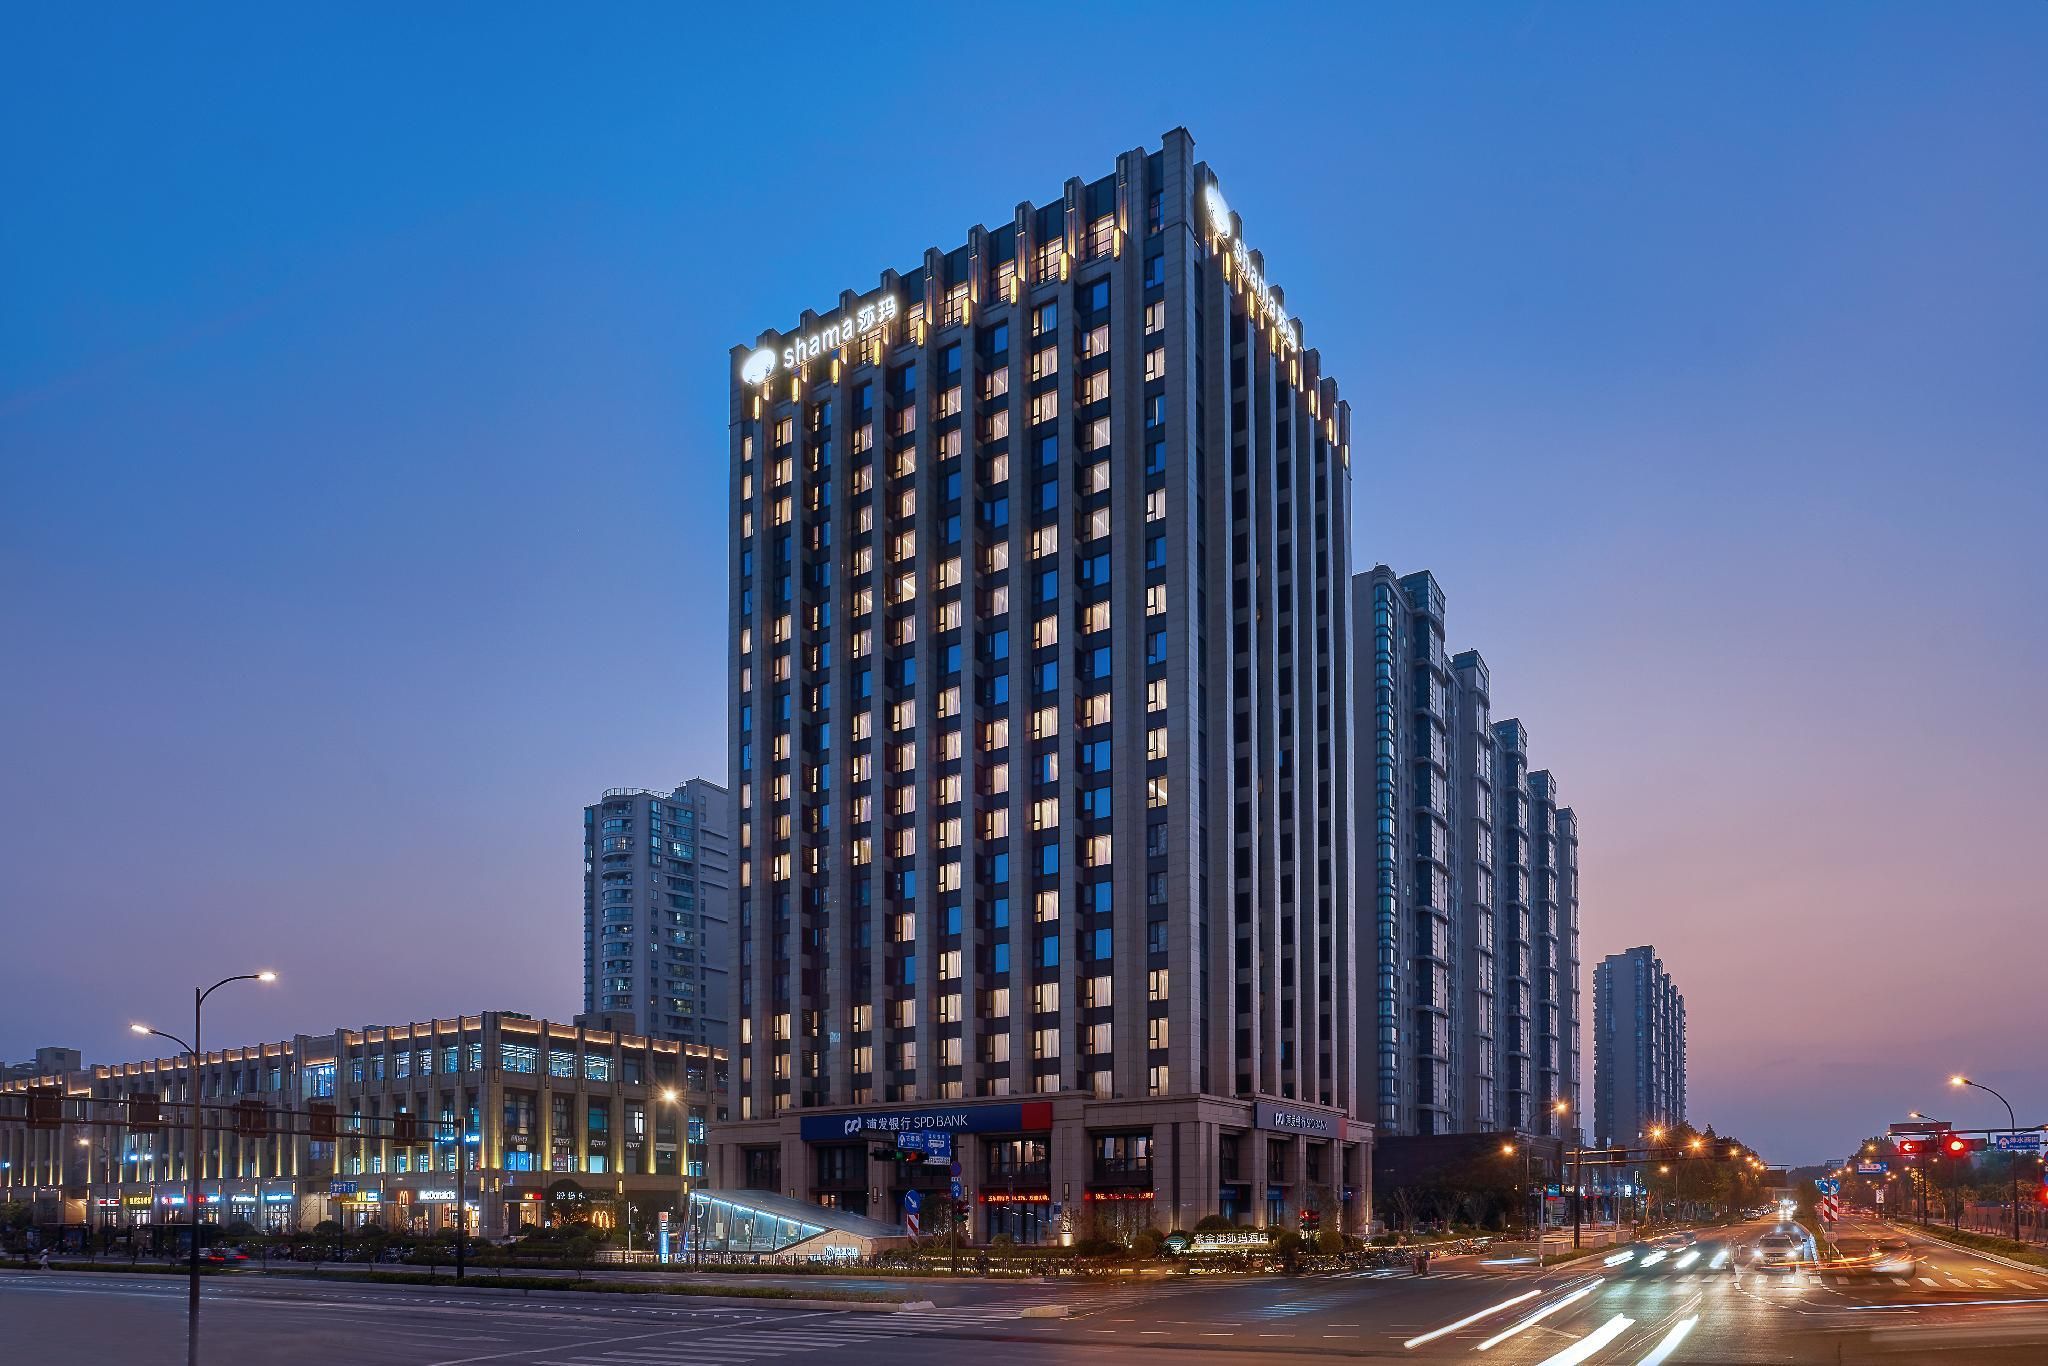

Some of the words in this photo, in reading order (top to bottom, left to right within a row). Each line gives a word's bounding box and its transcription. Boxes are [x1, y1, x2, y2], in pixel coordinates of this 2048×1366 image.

[783, 318, 854, 368] shama
[866, 1115, 911, 1130] 浦发银行
[914, 1116, 935, 1129] SPD
[936, 1114, 968, 1127] BANK
[419, 1190, 456, 1201] McDonald's
